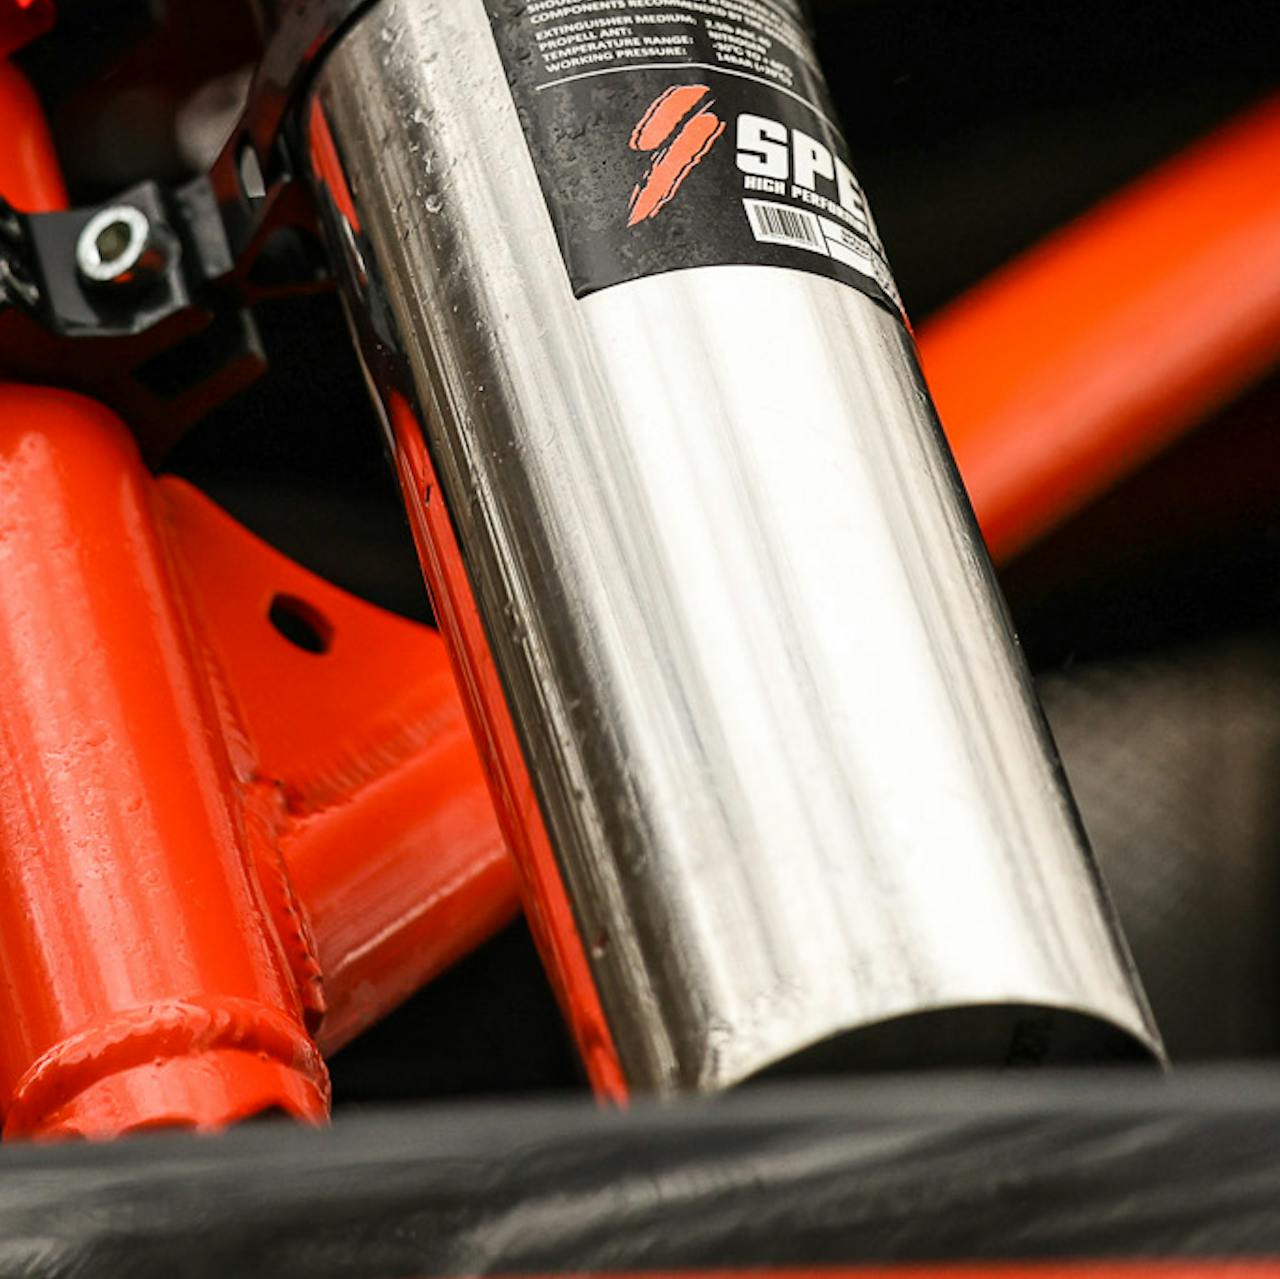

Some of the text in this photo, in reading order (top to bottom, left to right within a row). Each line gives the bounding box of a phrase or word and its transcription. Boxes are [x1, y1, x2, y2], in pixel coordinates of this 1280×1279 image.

[530, 0, 626, 24] COMPONENTS
[727, 10, 742, 22] BY
[535, 15, 634, 41] EXTINGUISHER
[539, 31, 598, 52] PROPELL
[600, 26, 633, 38] ANT:
[707, 29, 767, 55] NITROGEN
[542, 37, 641, 63] TEMPERATURE
[642, 35, 694, 46] RANGE:
[745, 48, 761, 61] TO
[545, 50, 614, 73] WORKING
[615, 46, 687, 60] PRESSURE:
[744, 175, 786, 196] HIGH
